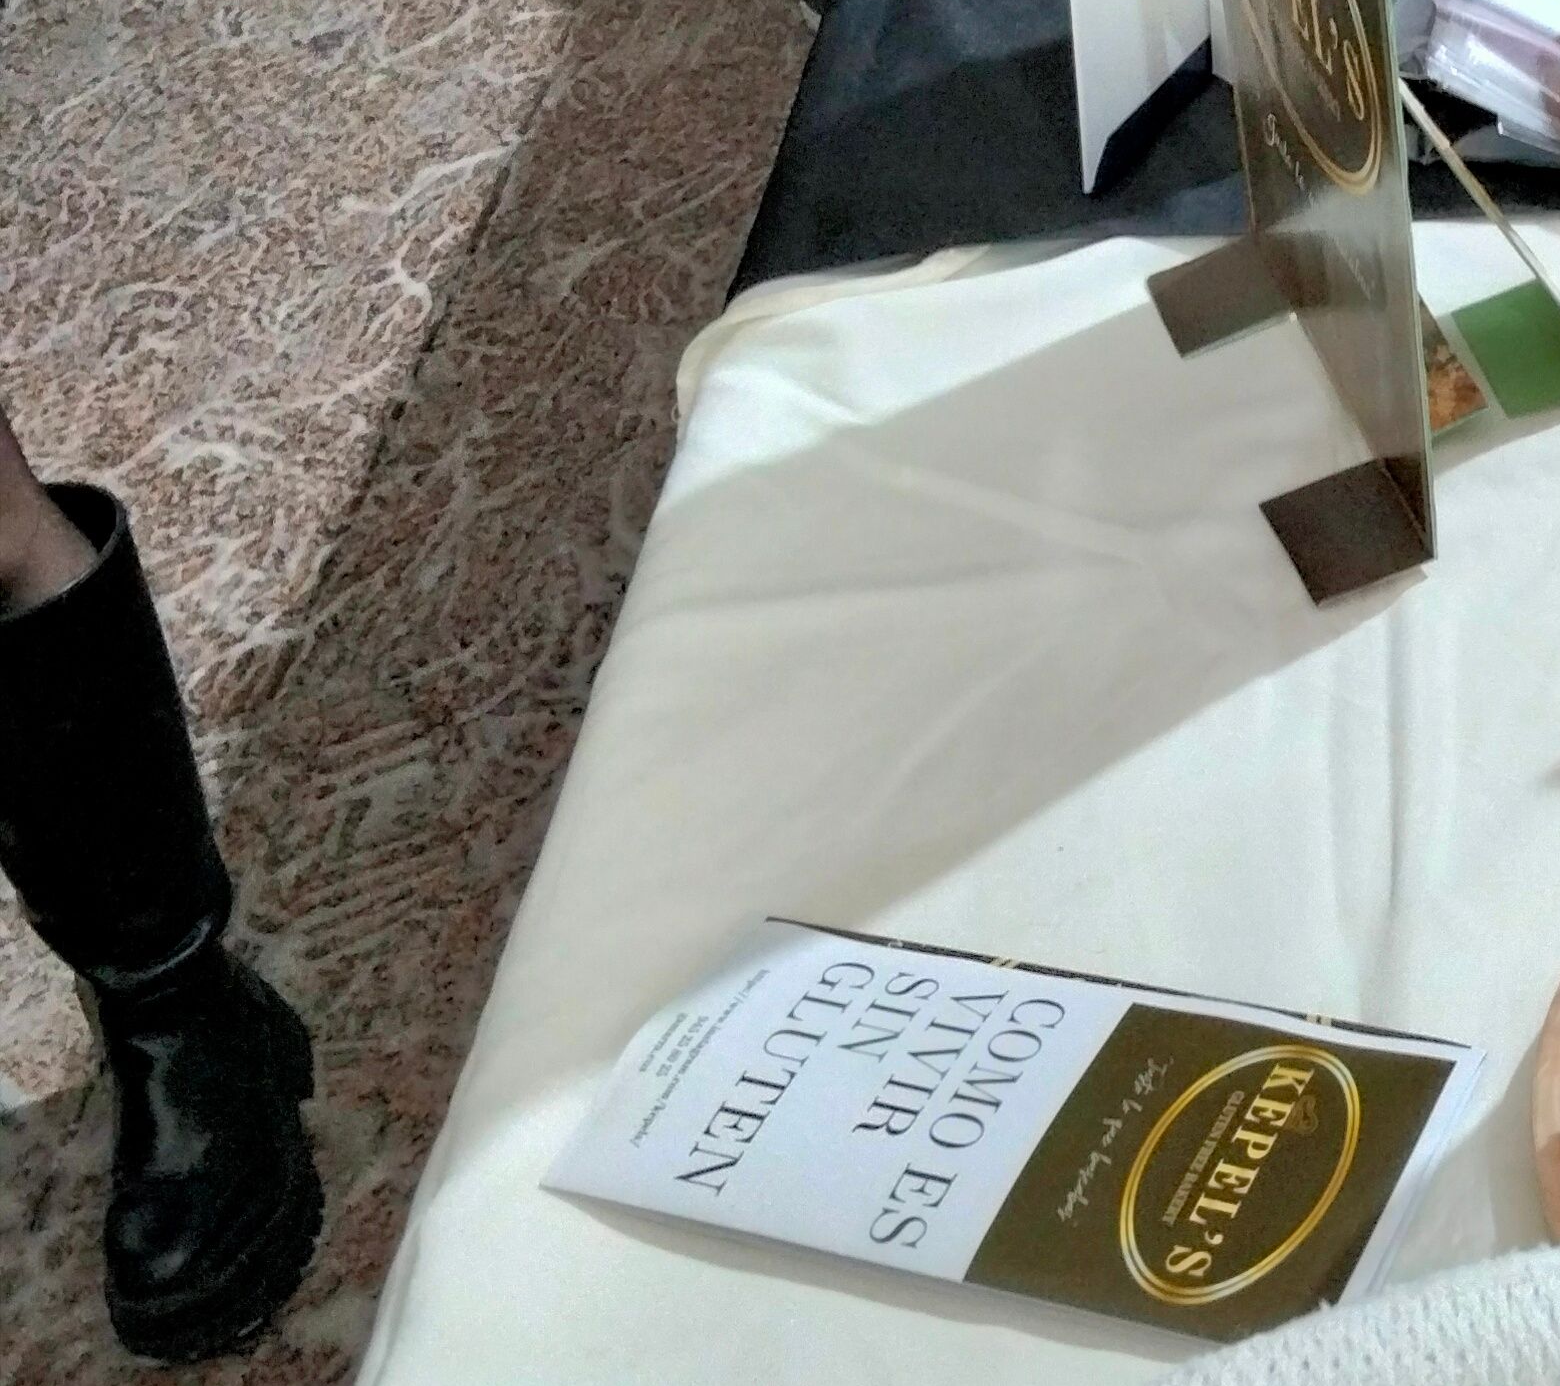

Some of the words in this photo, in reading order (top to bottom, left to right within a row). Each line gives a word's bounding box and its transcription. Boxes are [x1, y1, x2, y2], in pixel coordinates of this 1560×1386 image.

[837, 972, 940, 1063] SIN
[673, 961, 876, 1197] GLUTEN
[851, 990, 1010, 1137] VIVIR
[928, 998, 1066, 1150] COMO
[1189, 1140, 1221, 1173] FREE
[1209, 1090, 1244, 1142] GLUTEN
[868, 1162, 959, 1250] ES
[1161, 1171, 1197, 1227] BAKERY
[1165, 1063, 1315, 1278] KEPEL'S
